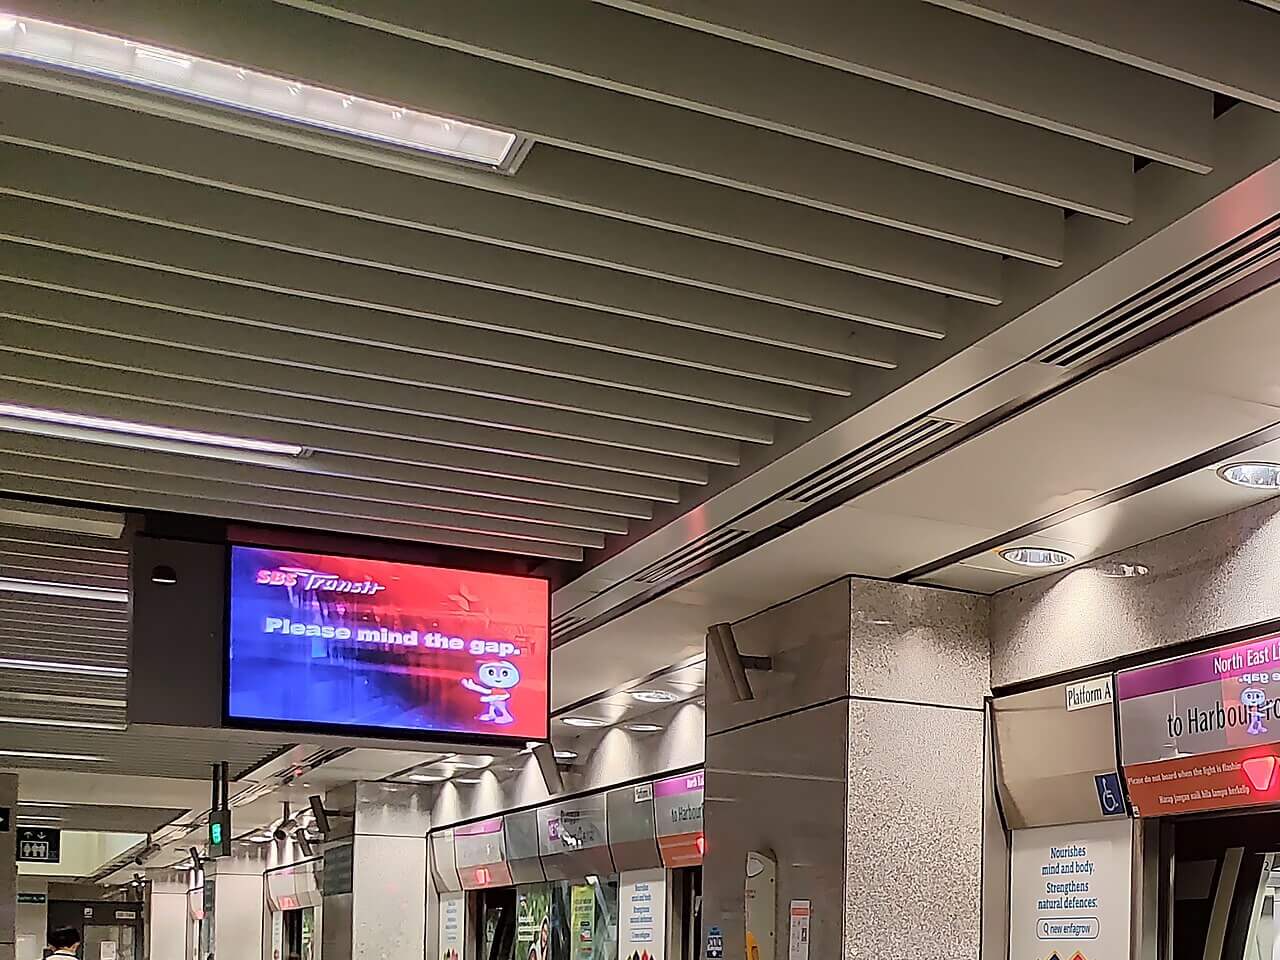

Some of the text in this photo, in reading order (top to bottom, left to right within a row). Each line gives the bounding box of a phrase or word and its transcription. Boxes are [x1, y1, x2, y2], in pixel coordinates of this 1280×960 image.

[256, 569, 386, 595] SBS Transit
[264, 617, 521, 657] Please mind the gap.
[1213, 652, 1242, 674] North
[1247, 647, 1270, 667] East
[1068, 681, 1111, 706] Platform A
[1167, 714, 1183, 738] to
[1050, 846, 1086, 859] Nourishes
[1041, 864, 1060, 875] mind
[1060, 863, 1074, 874] and
[1046, 881, 1089, 896] Strengthens
[1038, 899, 1063, 910] natural
[1050, 923, 1091, 936] new enfagrow
